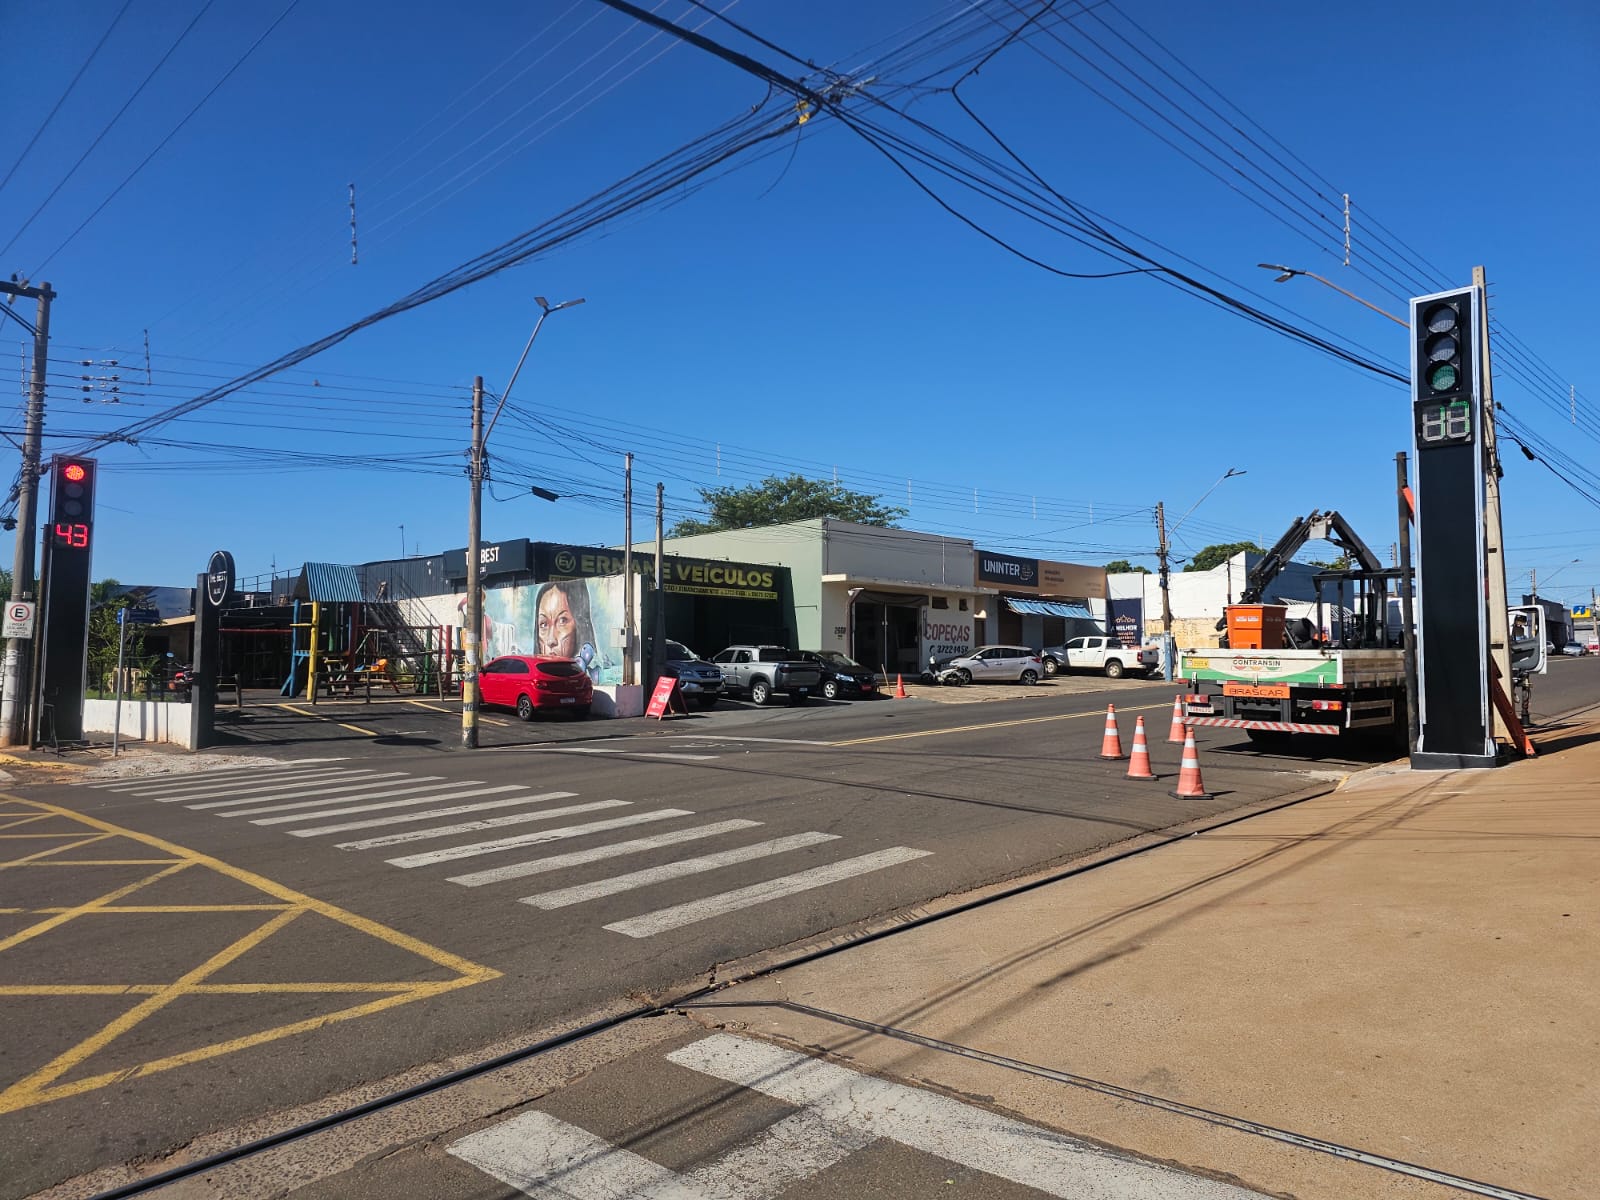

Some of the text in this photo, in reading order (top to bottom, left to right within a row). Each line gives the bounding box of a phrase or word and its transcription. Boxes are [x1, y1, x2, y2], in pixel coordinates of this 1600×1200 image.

[56, 523, 88, 547] 43
[481, 546, 500, 564] BEST
[676, 562, 773, 588] VEÍCULOS
[984, 559, 1020, 577] UNINTER
[15, 608, 24, 618] E
[1233, 659, 1281, 667] CONTRANSIN
[1229, 687, 1284, 697] BRASCAR
